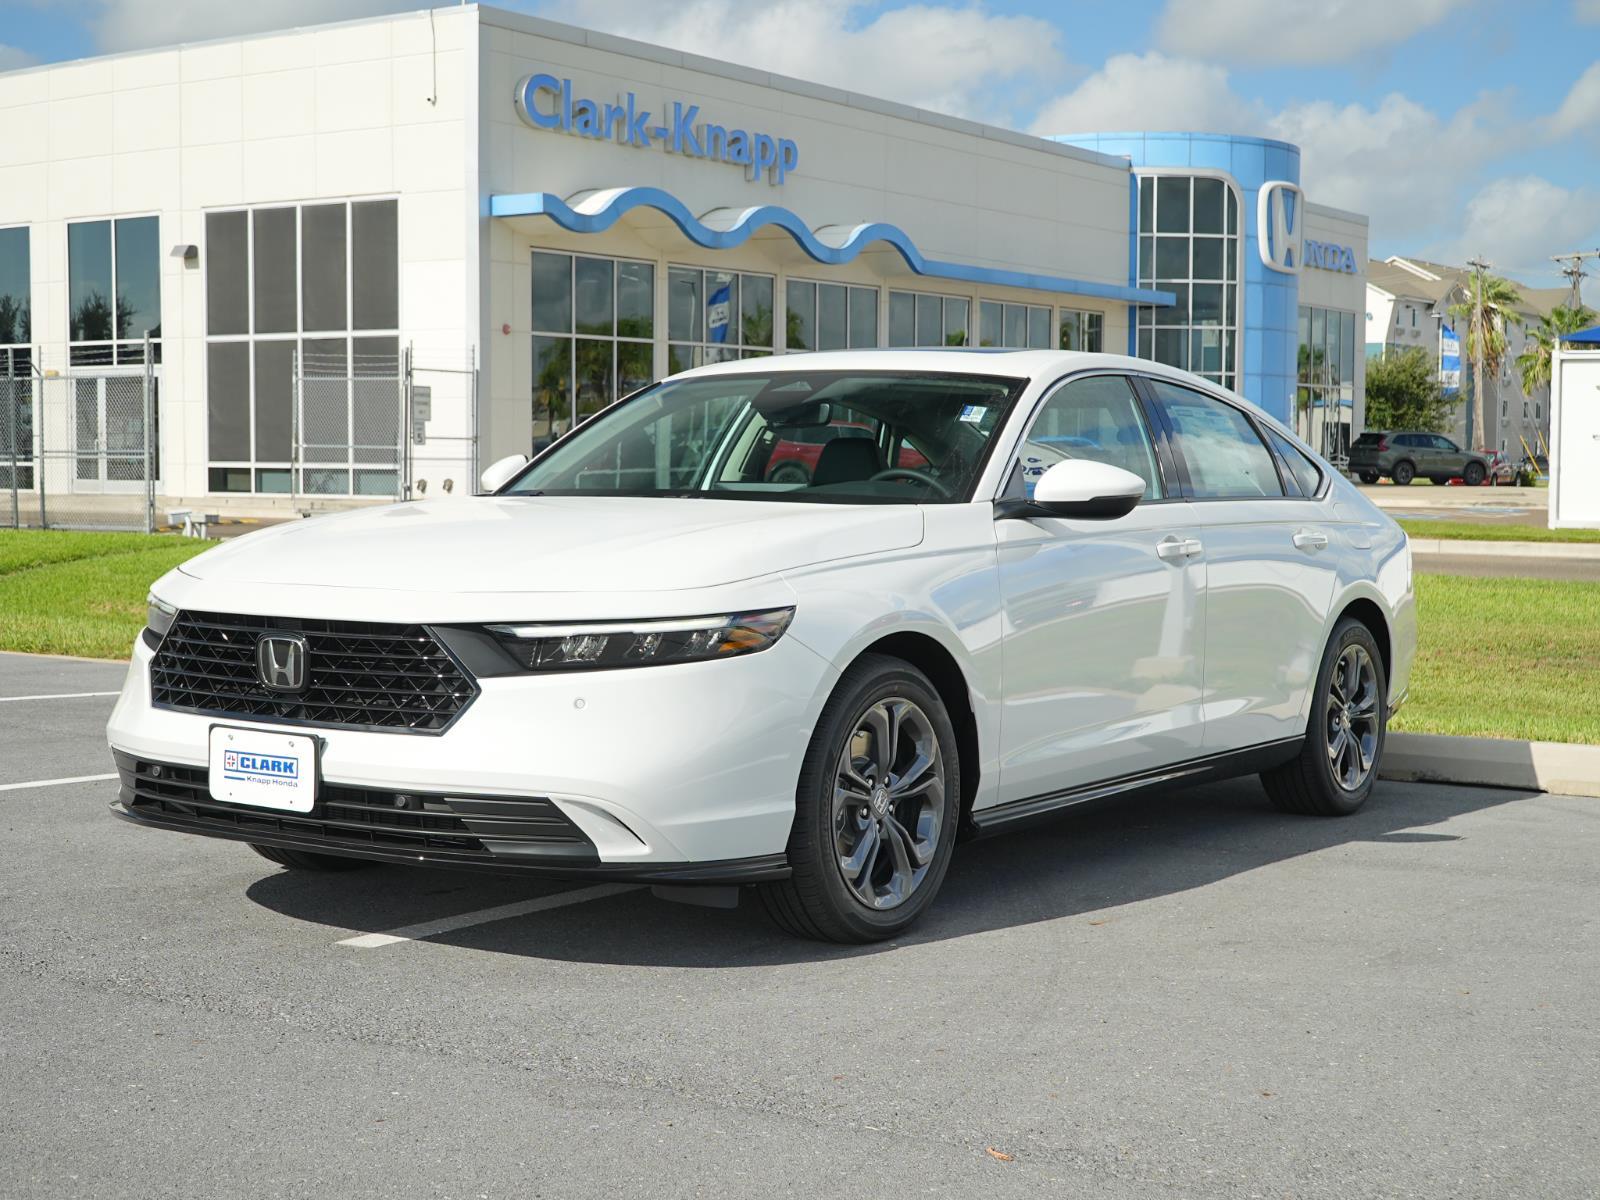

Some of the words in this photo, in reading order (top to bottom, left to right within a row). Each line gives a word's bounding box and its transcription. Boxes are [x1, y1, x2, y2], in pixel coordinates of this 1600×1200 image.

[521, 73, 799, 185] Clark-Knapp
[240, 756, 294, 774] CLARK
[246, 775, 271, 785] Knapp
[272, 779, 299, 788] Honda
